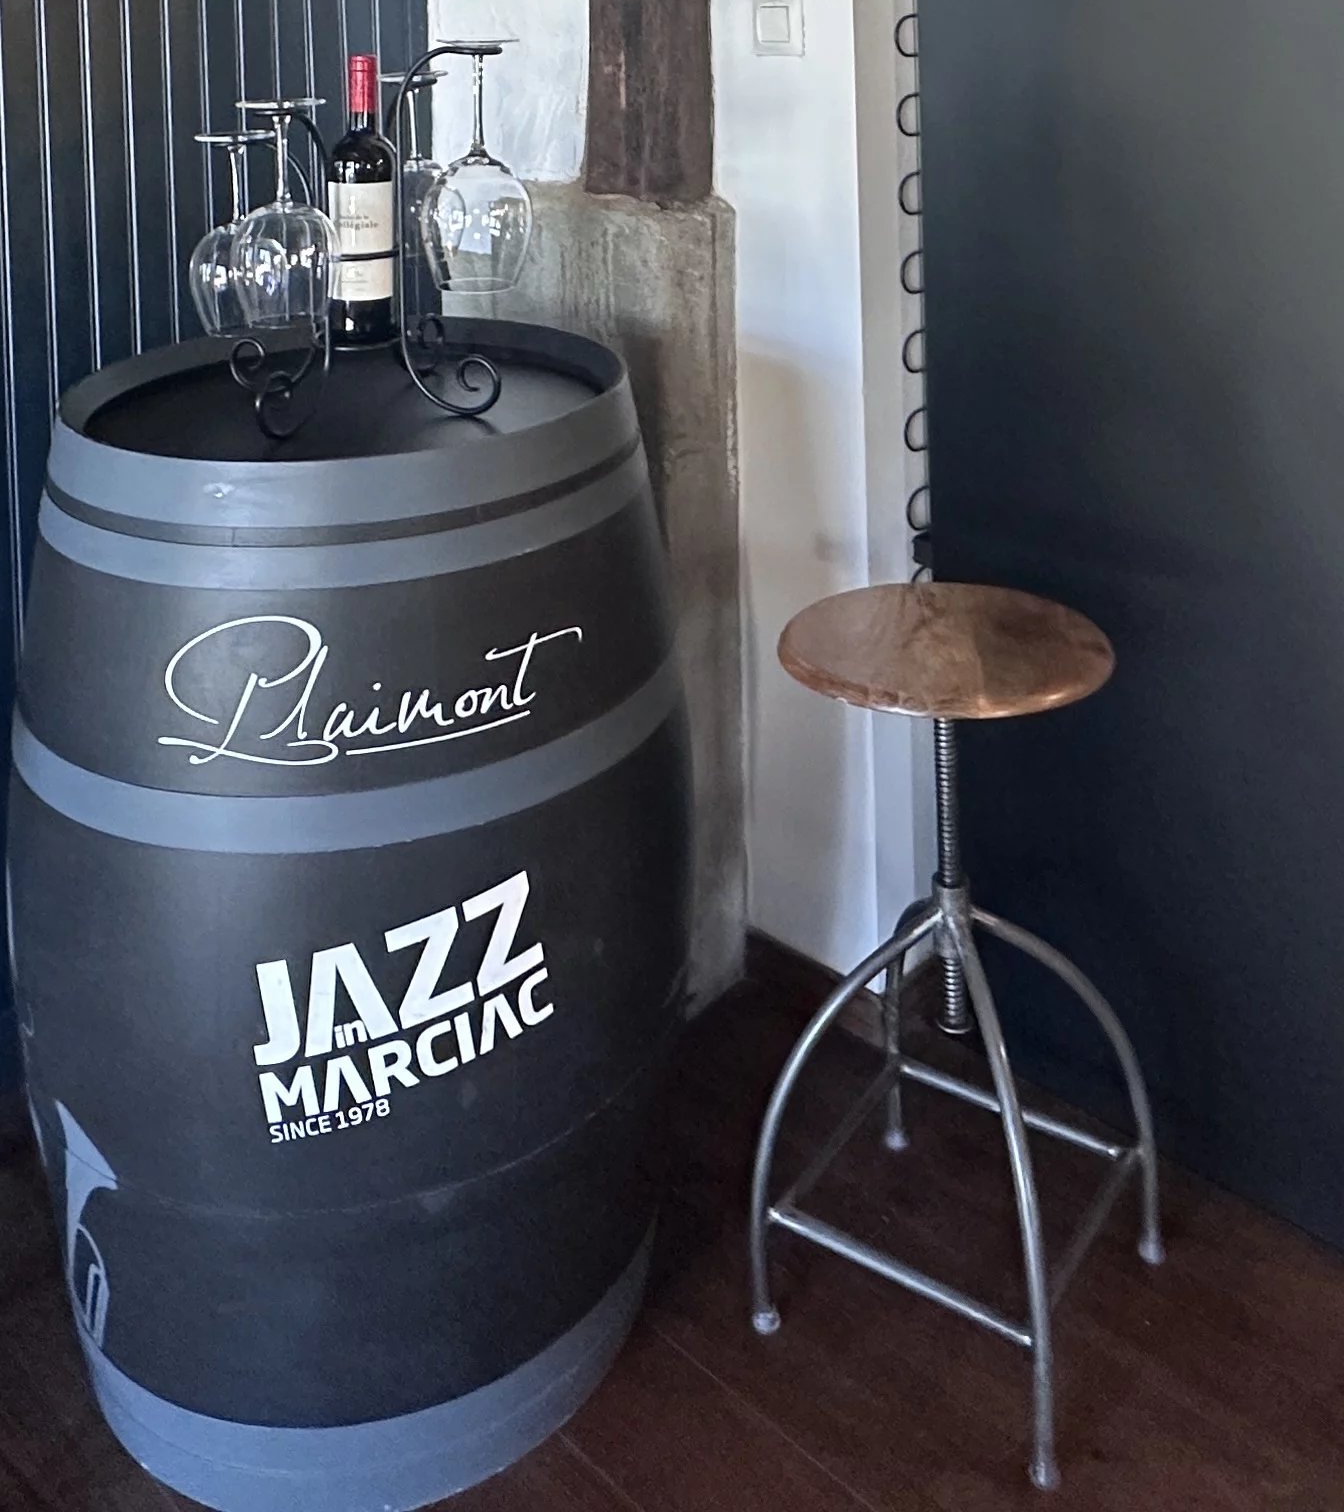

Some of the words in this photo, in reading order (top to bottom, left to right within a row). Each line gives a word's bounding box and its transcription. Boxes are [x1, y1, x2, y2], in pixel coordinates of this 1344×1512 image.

[157, 615, 583, 766] Plaimont
[253, 870, 545, 1066] JAZZ
[333, 1019, 369, 1049] in
[258, 967, 554, 1123] MARCIAC
[268, 1115, 333, 1144] SINCE
[335, 1098, 391, 1130] 1978
